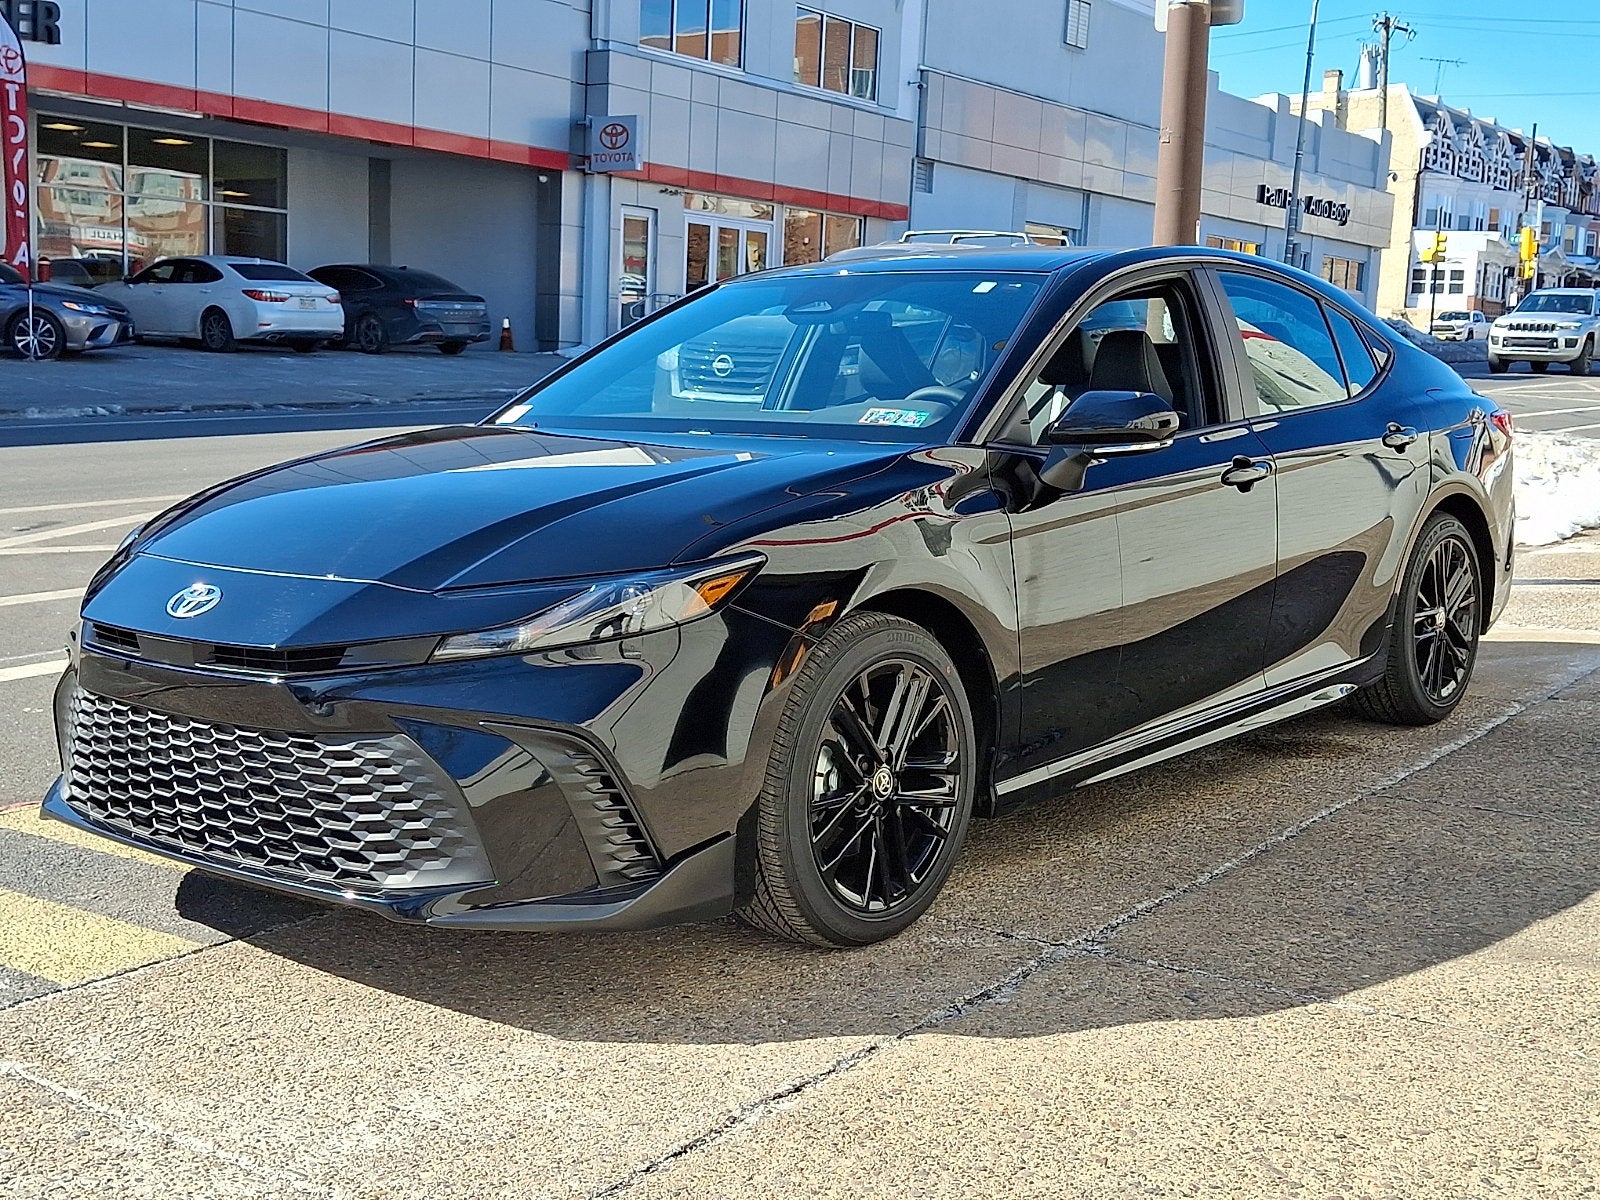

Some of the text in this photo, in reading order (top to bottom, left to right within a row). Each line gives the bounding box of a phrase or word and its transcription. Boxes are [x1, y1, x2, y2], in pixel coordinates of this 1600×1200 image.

[0, 0, 61, 44] ER
[5, 83, 29, 267] TOYOA
[593, 152, 634, 163] TOYOTA
[1258, 184, 1288, 209] Paul
[1307, 196, 1330, 218] Auto
